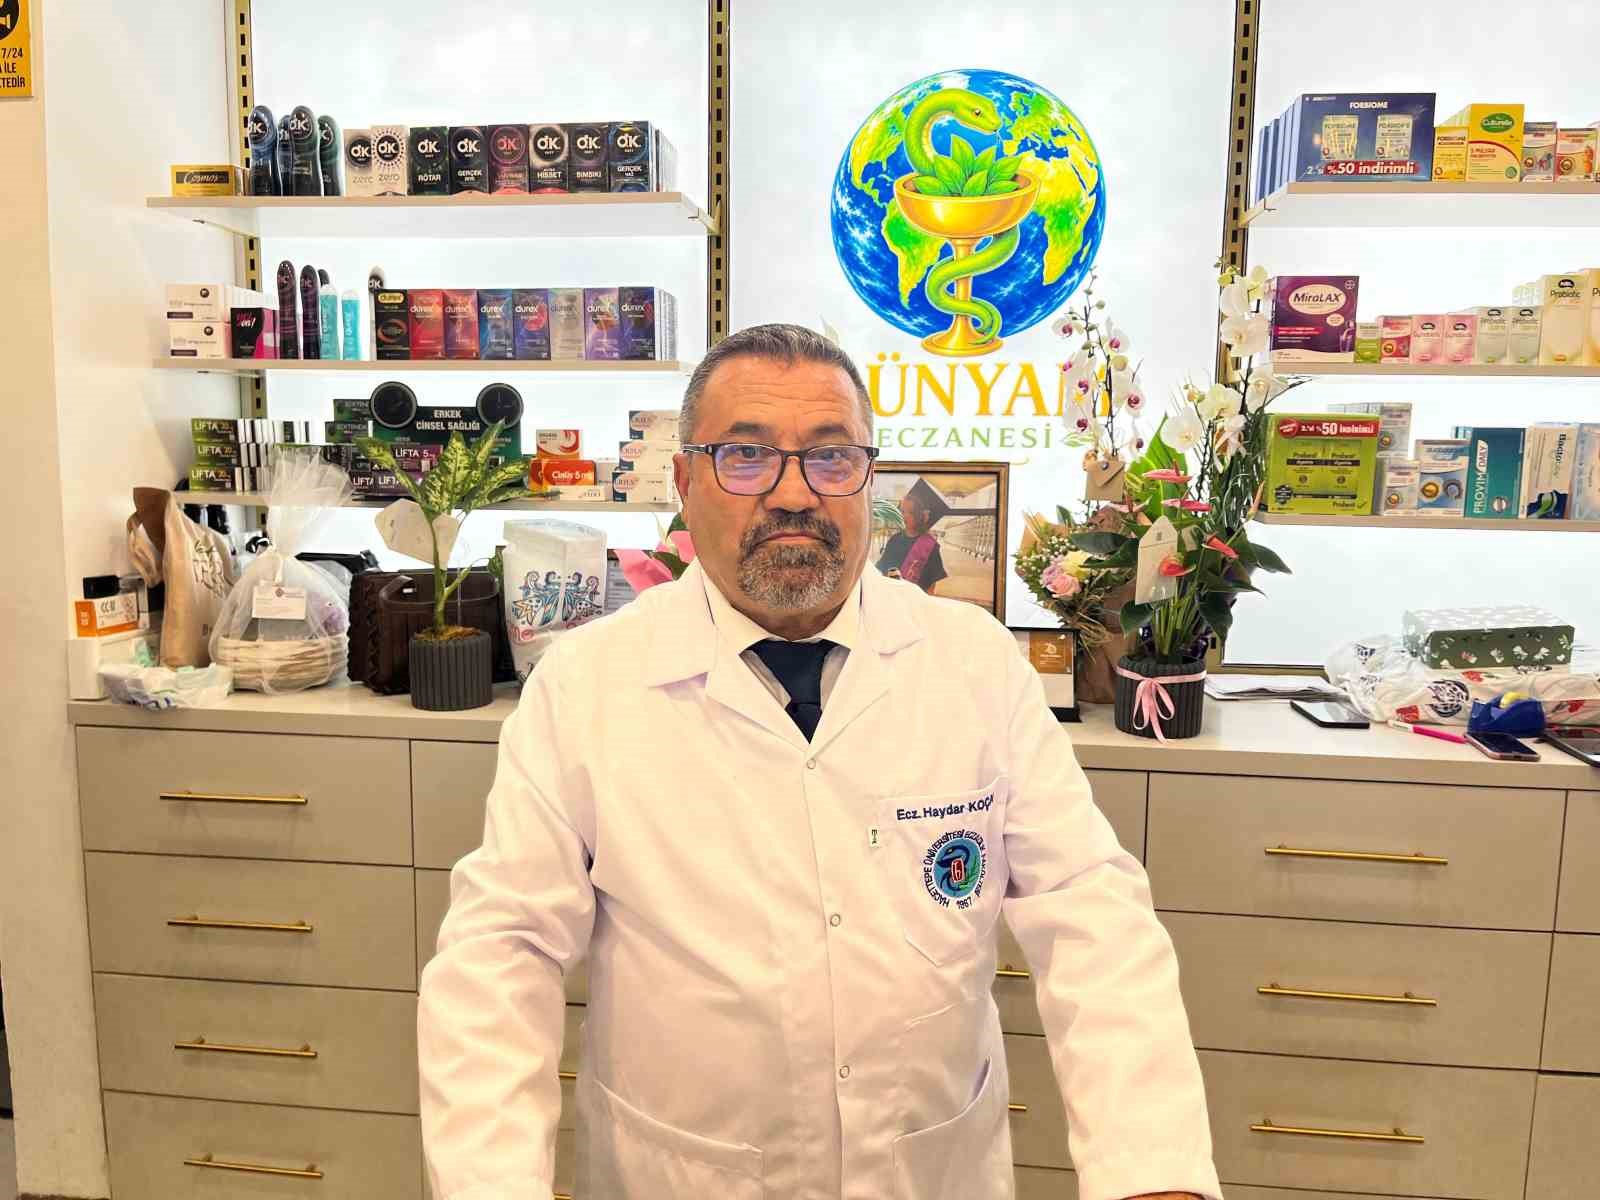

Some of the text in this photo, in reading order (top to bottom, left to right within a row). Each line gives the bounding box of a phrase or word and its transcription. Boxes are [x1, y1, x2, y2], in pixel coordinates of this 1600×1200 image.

[2, 47, 23, 58] 7/24
[4, 61, 17, 74] İLE
[1358, 161, 1414, 174] indirimli
[480, 304, 503, 313] durex
[515, 304, 538, 313] durex
[621, 303, 645, 312] durex
[433, 409, 462, 419] ERKEK
[416, 421, 480, 431] CİNSEL SAĞLIĞI
[876, 423, 1051, 448] ECZANESİ
[897, 808, 920, 821] Ecz.
[923, 804, 965, 819] Haydar
